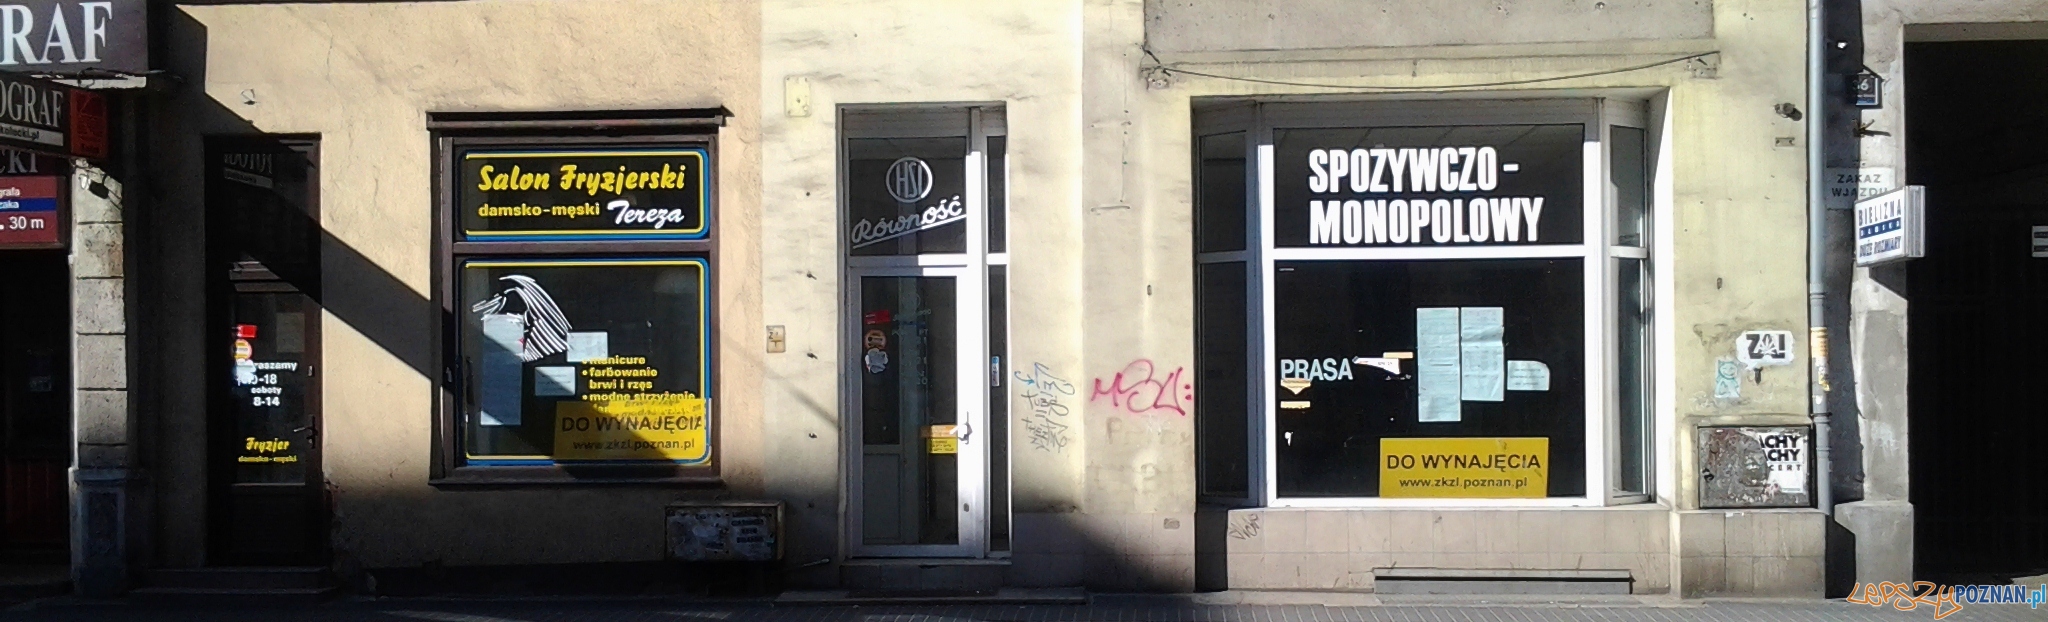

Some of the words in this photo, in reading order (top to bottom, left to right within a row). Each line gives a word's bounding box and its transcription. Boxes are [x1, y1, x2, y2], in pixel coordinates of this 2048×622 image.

[478, 165, 550, 191] Salon
[560, 163, 686, 196] Fryzjerski
[1837, 174, 1881, 184] ZAKAZ
[478, 202, 600, 218] damsko-męski
[607, 200, 685, 229] Tereza
[852, 195, 962, 244] Równość
[1309, 197, 1543, 244] MONOPOLOWY
[1858, 199, 1902, 227] BIELIZNA
[9, 216, 27, 230] 30
[31, 218, 44, 229] m
[589, 355, 646, 365] manicure
[589, 367, 658, 377] farbowanie
[1280, 358, 1354, 381] PRASA
[589, 379, 617, 390] brwi
[619, 379, 625, 389] i
[627, 381, 653, 391] rzęs
[253, 396, 281, 407] 8-14
[589, 391, 631, 402] modne
[561, 416, 590, 432] DO
[595, 415, 703, 434] WYNAJĘCIA
[246, 437, 290, 453] Fryzjer
[572, 438, 695, 453] www.zkzl.poznan.pl
[1386, 455, 1416, 470] DO
[1419, 454, 1542, 473] WYNAJĘCIA
[1398, 477, 1528, 490] www.zkzl.poznan.pl
